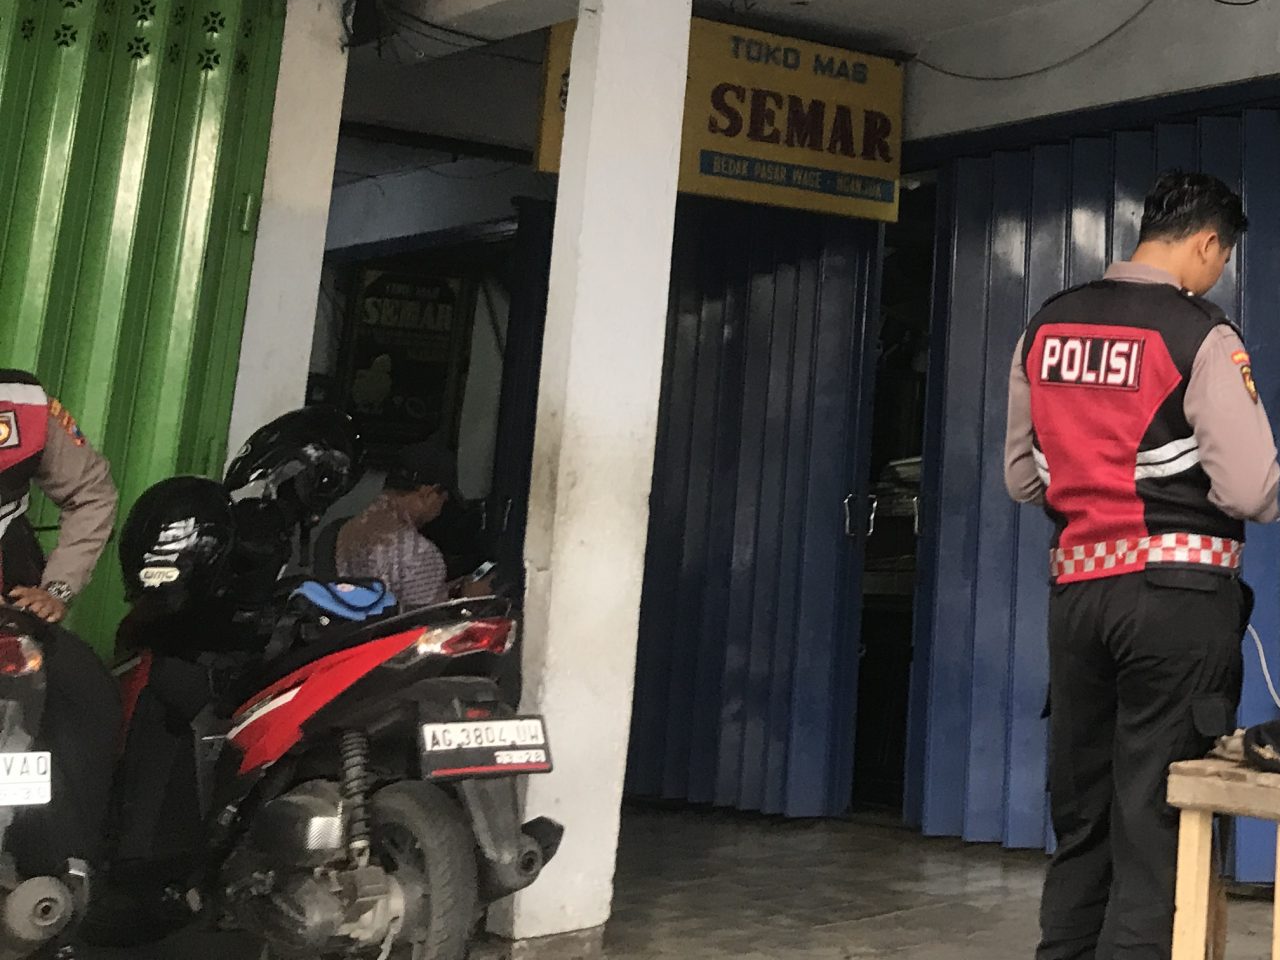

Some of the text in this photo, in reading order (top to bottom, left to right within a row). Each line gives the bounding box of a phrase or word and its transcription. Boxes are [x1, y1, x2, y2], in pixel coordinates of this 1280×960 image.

[730, 34, 870, 84] TOKO MAS
[707, 81, 894, 164] SEMAR
[1041, 337, 1139, 386] POLISI
[431, 728, 453, 749] AG
[460, 726, 507, 746] 3804
